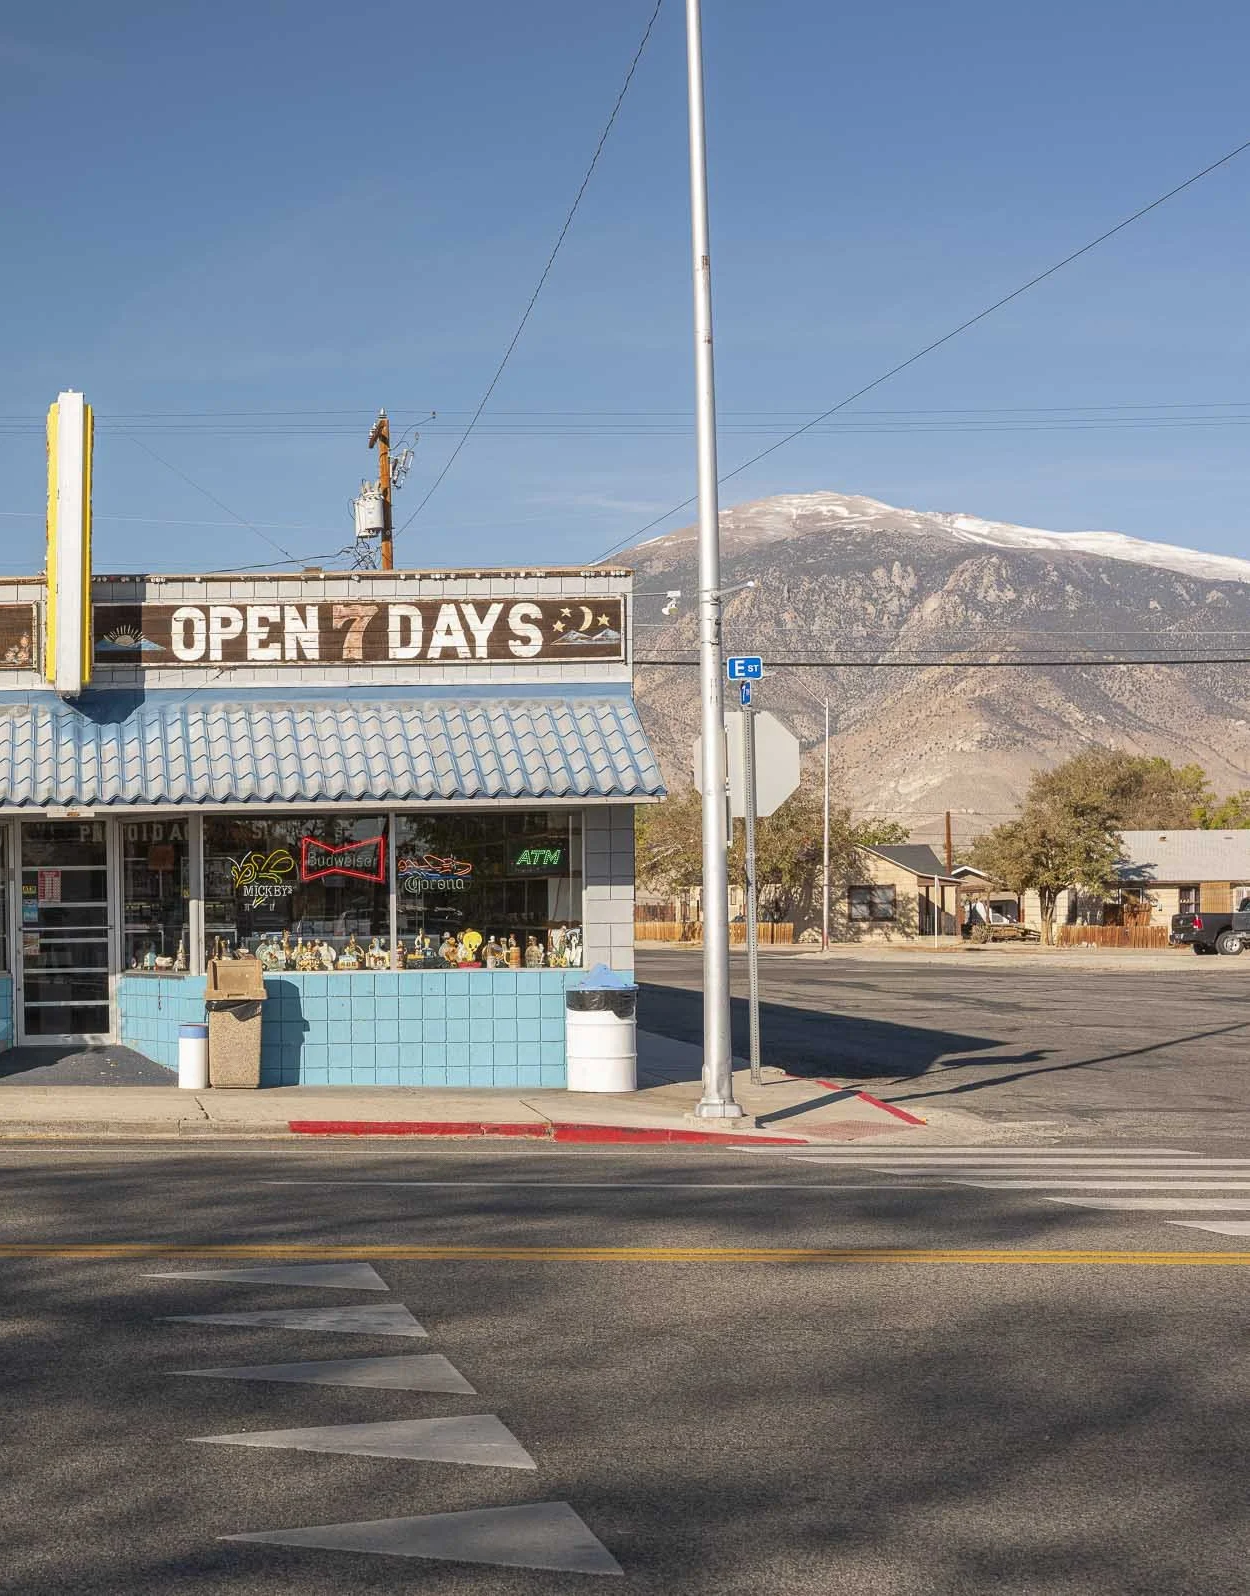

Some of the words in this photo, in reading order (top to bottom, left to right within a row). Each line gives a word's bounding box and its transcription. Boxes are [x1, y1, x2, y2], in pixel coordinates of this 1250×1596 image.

[171, 605, 320, 662] OPEN
[332, 604, 379, 660] 7
[387, 602, 544, 659] DAYS
[735, 660, 746, 677] E
[307, 851, 378, 868] Budweiser
[515, 849, 561, 865] ATM
[404, 876, 464, 894] Corona
